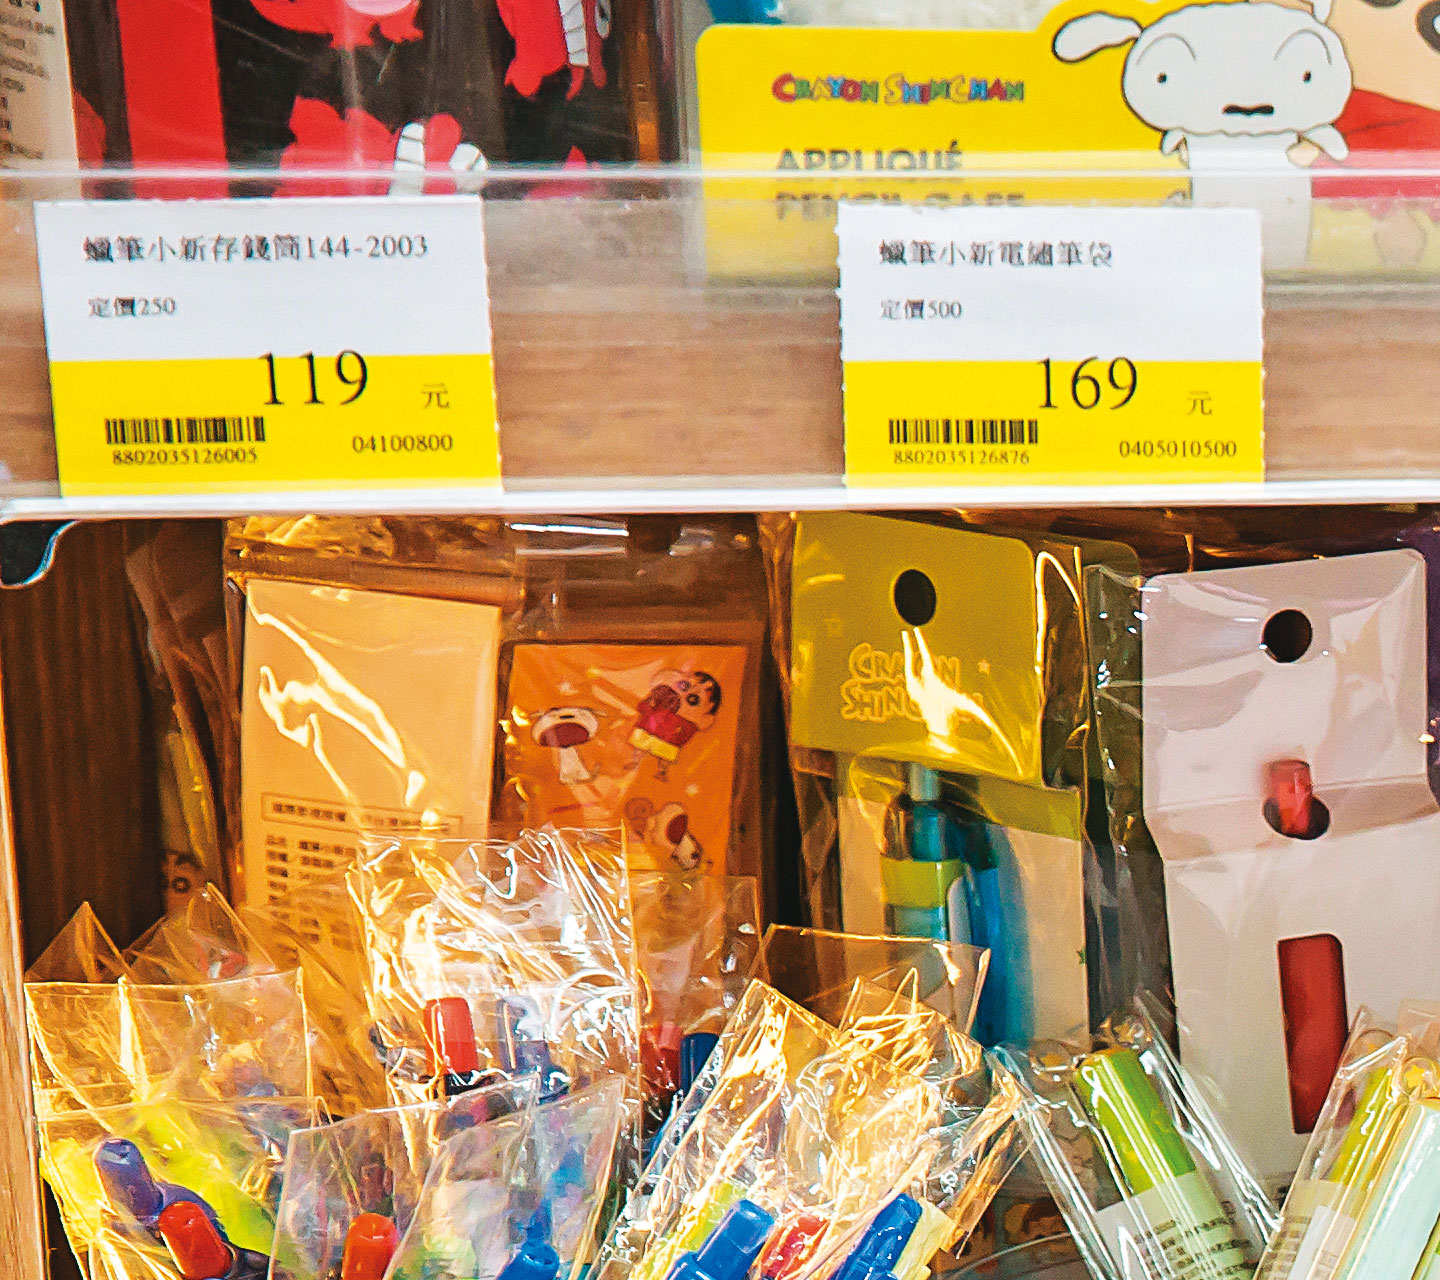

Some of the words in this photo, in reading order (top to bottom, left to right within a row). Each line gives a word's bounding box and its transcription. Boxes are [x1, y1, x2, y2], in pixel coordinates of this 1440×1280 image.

[260, 350, 369, 407] 119
[421, 383, 450, 410] 元
[1037, 356, 1139, 411] 169
[1186, 391, 1213, 416] 元
[352, 434, 453, 455] 04100800
[1118, 440, 1238, 461] 0405010500
